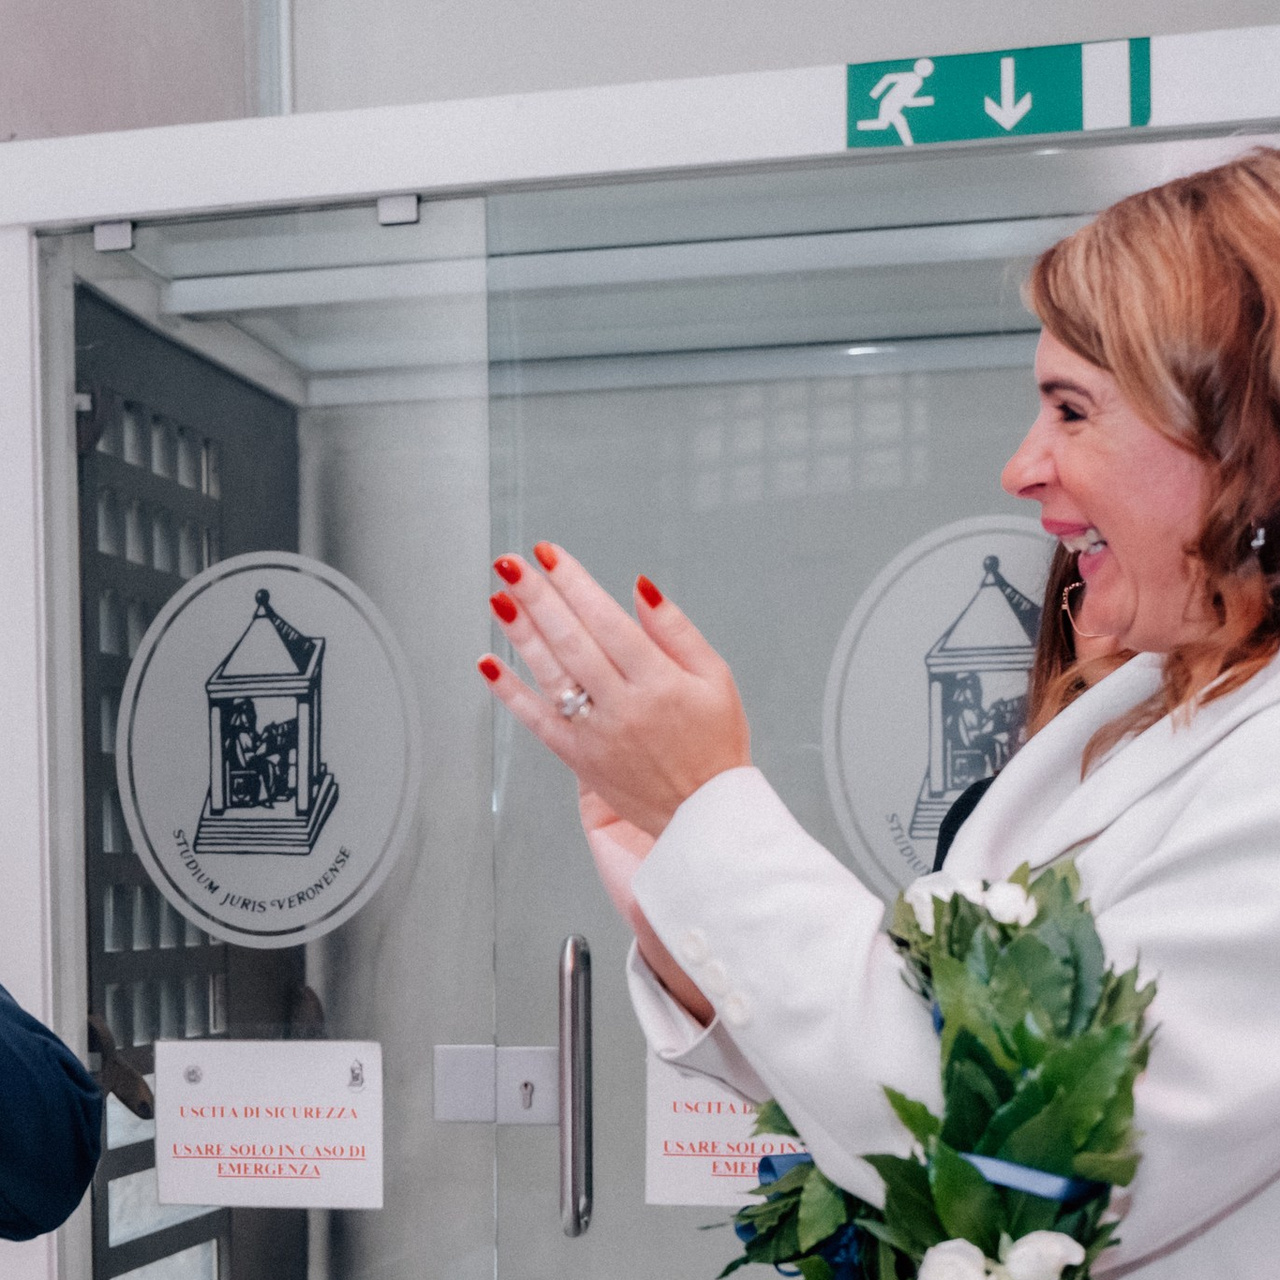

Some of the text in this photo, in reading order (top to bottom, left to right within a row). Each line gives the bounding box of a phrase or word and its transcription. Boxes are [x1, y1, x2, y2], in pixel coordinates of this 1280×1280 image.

[885, 812, 933, 876] STUDIU
[173, 828, 351, 913] STUDIUM JURIS VERONENSE
[179, 1105, 359, 1120] USCITA DI SICUREZZA
[672, 1100, 737, 1114] USCITA
[172, 1143, 366, 1158] USARE SOLO IN CASO DI
[662, 1140, 721, 1154] USARE
[726, 1141, 775, 1155] SOLO
[217, 1162, 321, 1176] EMERGENZA
